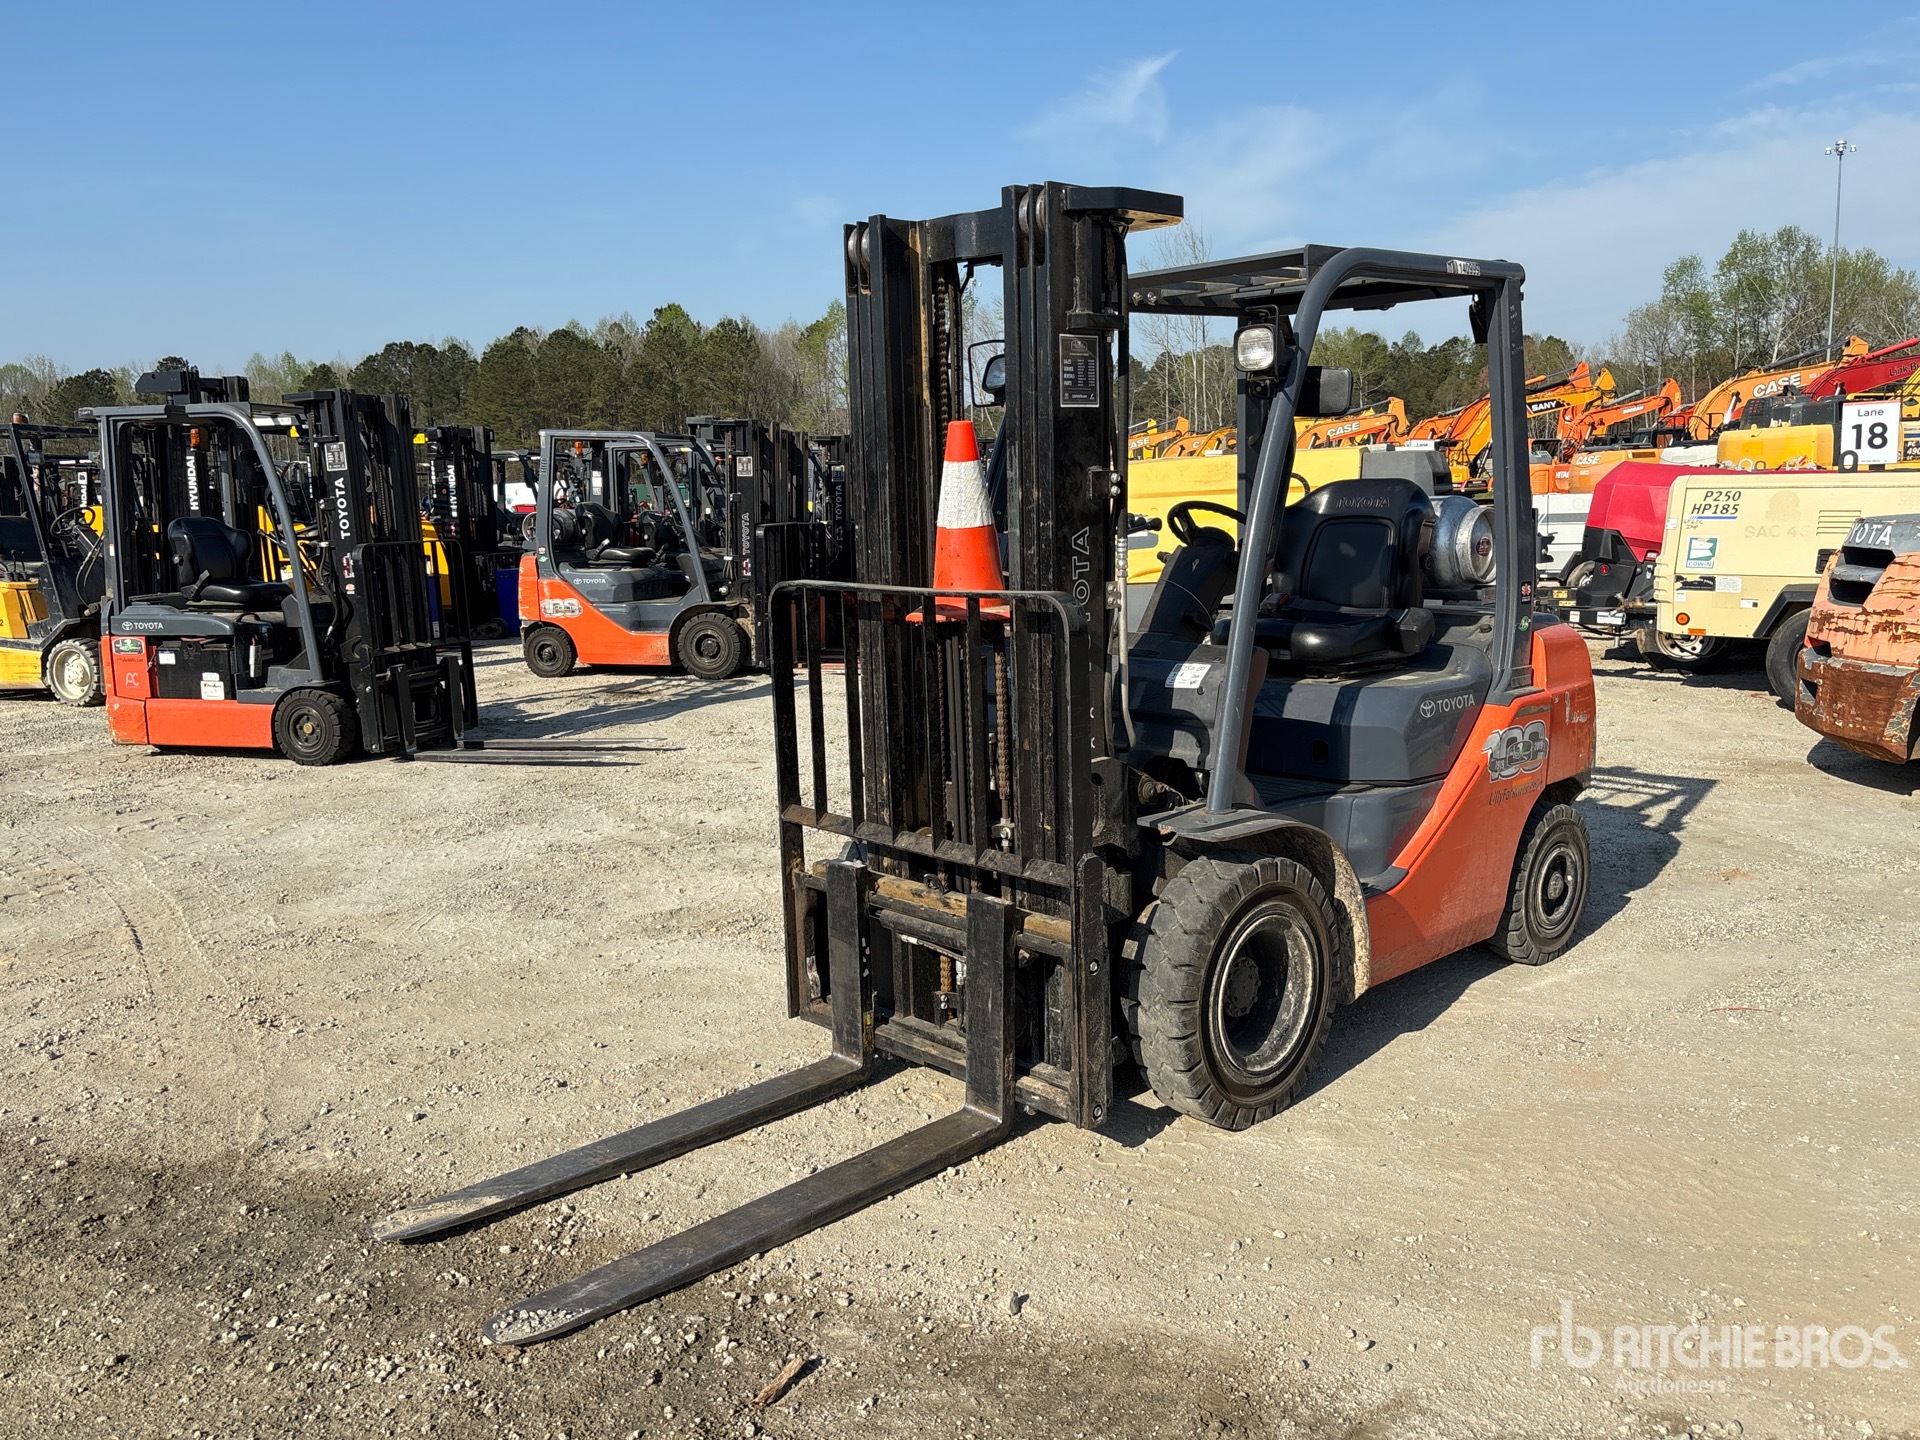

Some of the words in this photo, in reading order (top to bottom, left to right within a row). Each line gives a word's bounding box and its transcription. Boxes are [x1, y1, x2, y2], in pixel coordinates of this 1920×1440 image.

[1752, 373, 1801, 398] CASE
[1531, 401, 1557, 412] SANY
[1857, 408, 1884, 417] Lane
[1327, 421, 1360, 437] CASE
[1851, 422, 1888, 450] 18
[1128, 437, 1150, 449] ASE
[1576, 455, 1602, 465] CASE
[186, 455, 199, 511] HYUNDAI
[447, 465, 458, 509] HYUNDAI
[835, 484, 843, 521] TOYOTA
[1336, 496, 1391, 509] TOYOTA
[1703, 490, 1742, 502] P250
[335, 477, 351, 540] TOYOTA
[1691, 503, 1740, 515] HP185
[742, 512, 750, 556] TOYOTA
[133, 622, 164, 630] TOYOTA
[1437, 694, 1476, 713] TOYOTA
